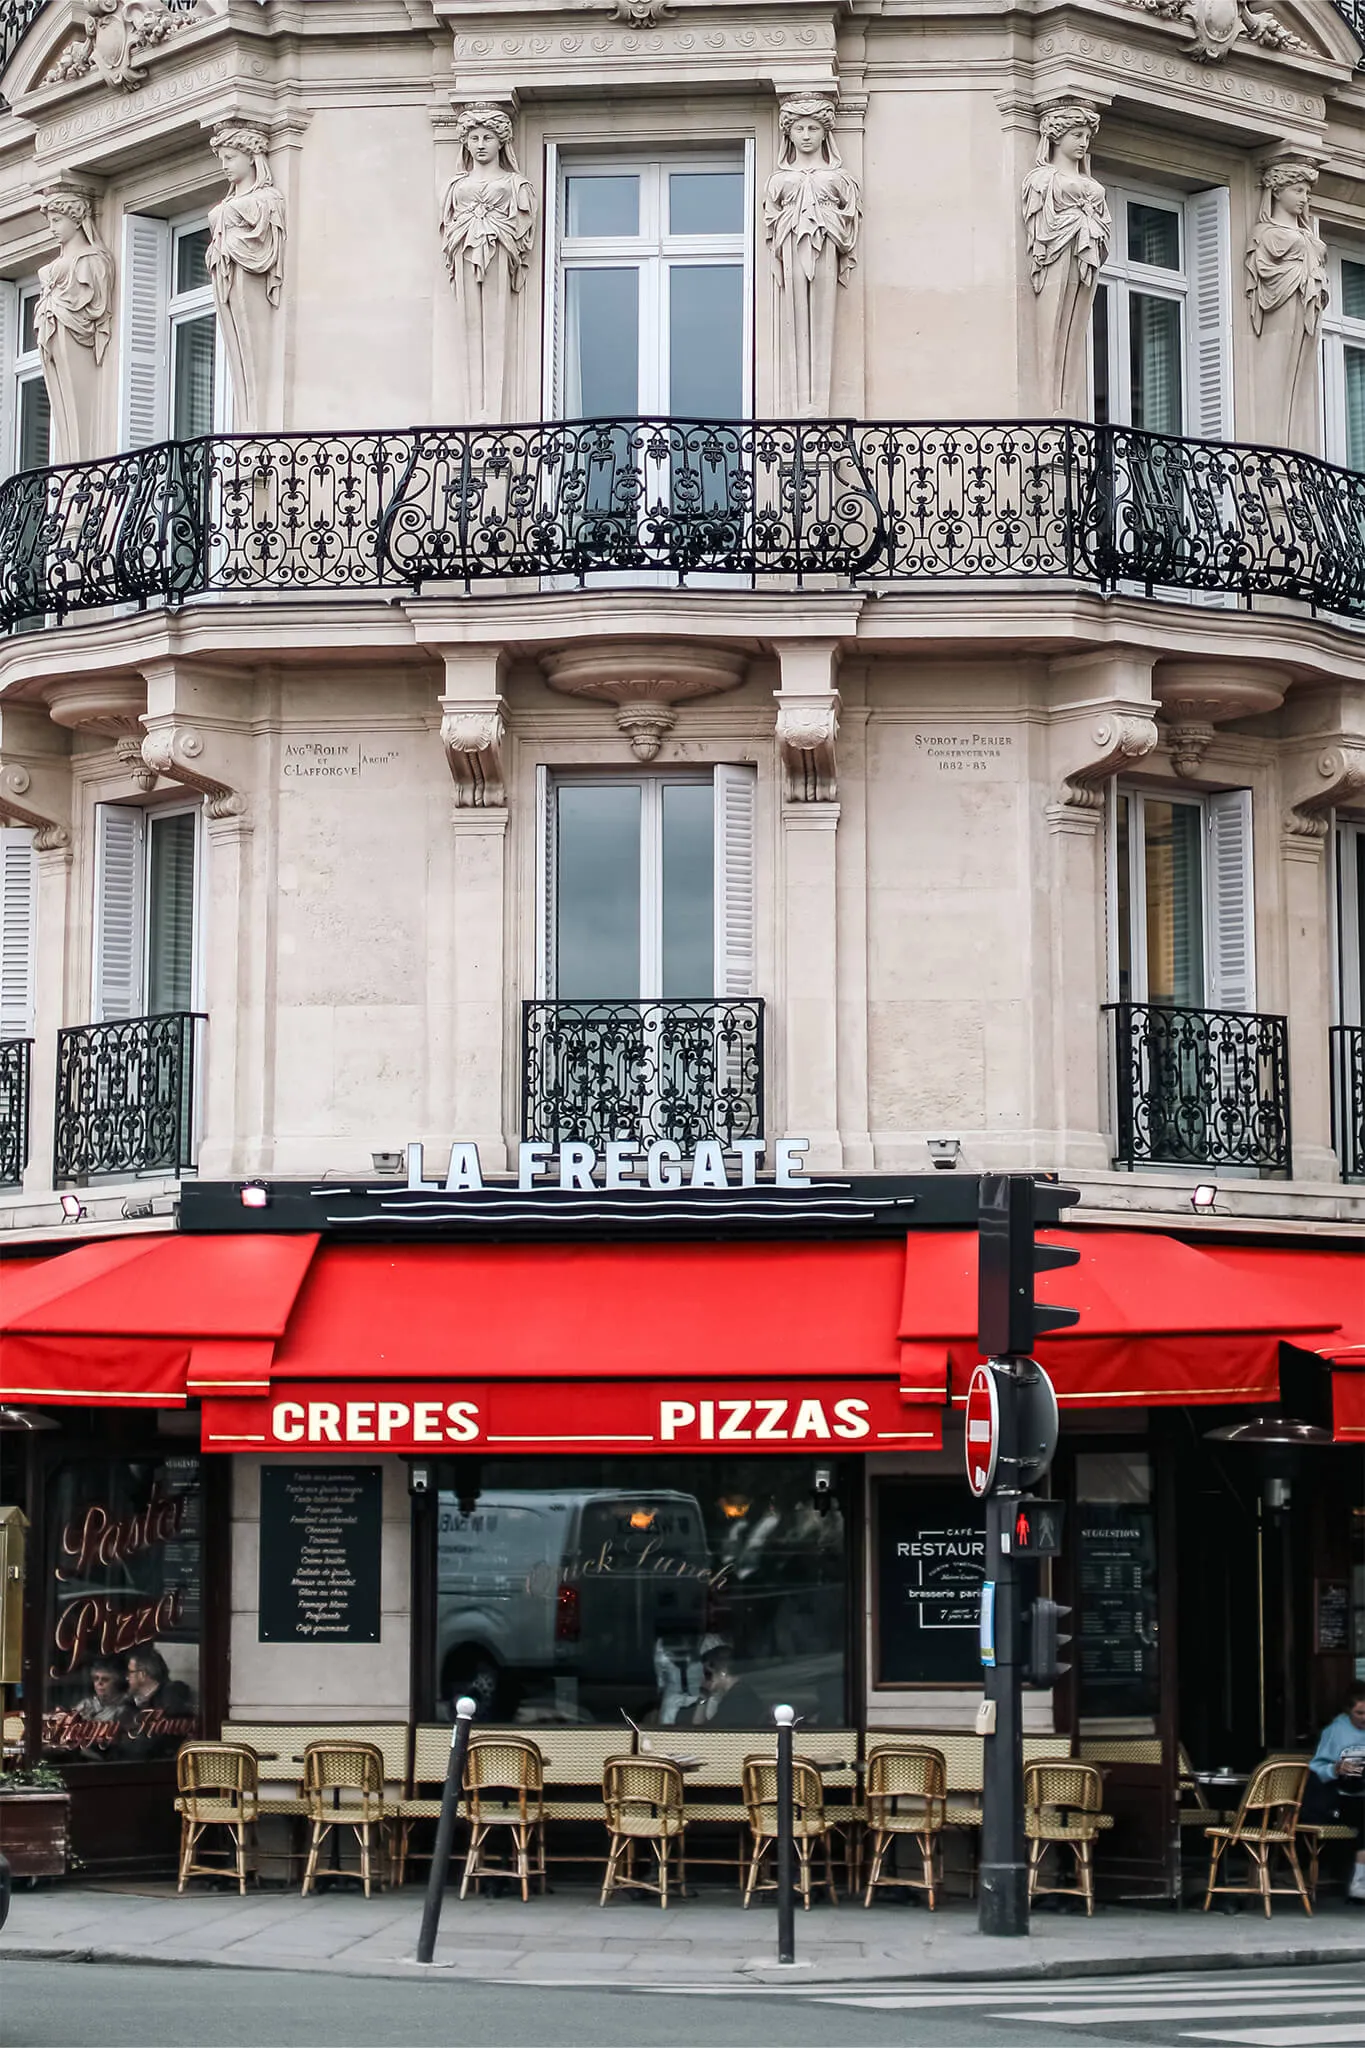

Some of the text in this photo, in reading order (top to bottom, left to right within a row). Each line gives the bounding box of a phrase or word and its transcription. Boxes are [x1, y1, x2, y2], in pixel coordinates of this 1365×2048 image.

[407, 1142, 483, 1190] LA
[271, 1398, 872, 1443] CREPES PIZZAS
[946, 1528, 973, 1536] CAFÉ
[897, 1542, 985, 1557] RESTAUR
[908, 1589, 956, 1599] brasserie
[940, 1609, 948, 1620] 7
[50, 1594, 180, 1680] Pizza
